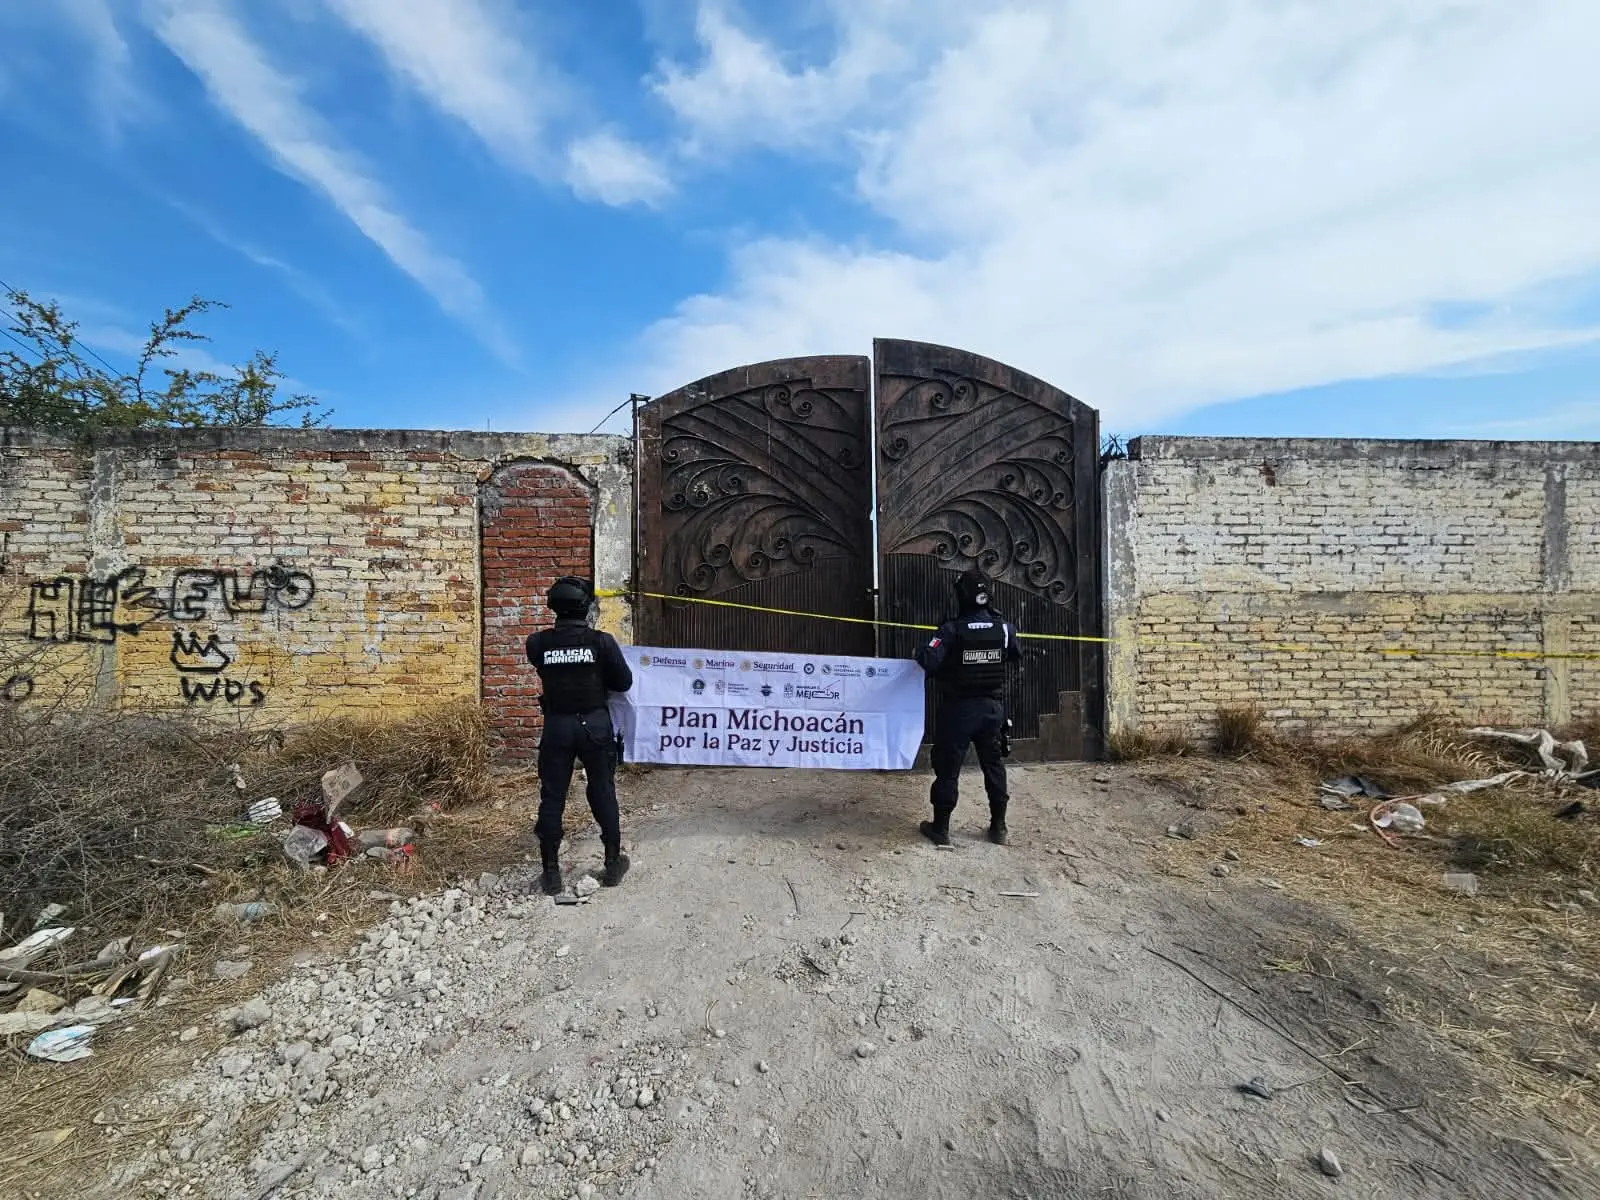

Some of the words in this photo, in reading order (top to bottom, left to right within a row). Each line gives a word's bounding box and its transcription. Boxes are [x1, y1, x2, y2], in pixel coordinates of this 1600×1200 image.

[543, 655, 596, 664] MUNICIPAL
[652, 656, 687, 665] Defensa
[964, 652, 987, 661] GUARDIA
[705, 659, 735, 668] Marina
[753, 661, 795, 671] Seguridad
[660, 706, 718, 729] Plan
[727, 709, 864, 734] Michoacán
[659, 734, 695, 752] por
[702, 733, 720, 750] la
[727, 734, 762, 751] Paz
[768, 738, 780, 756] y
[786, 736, 864, 755] Justicia
